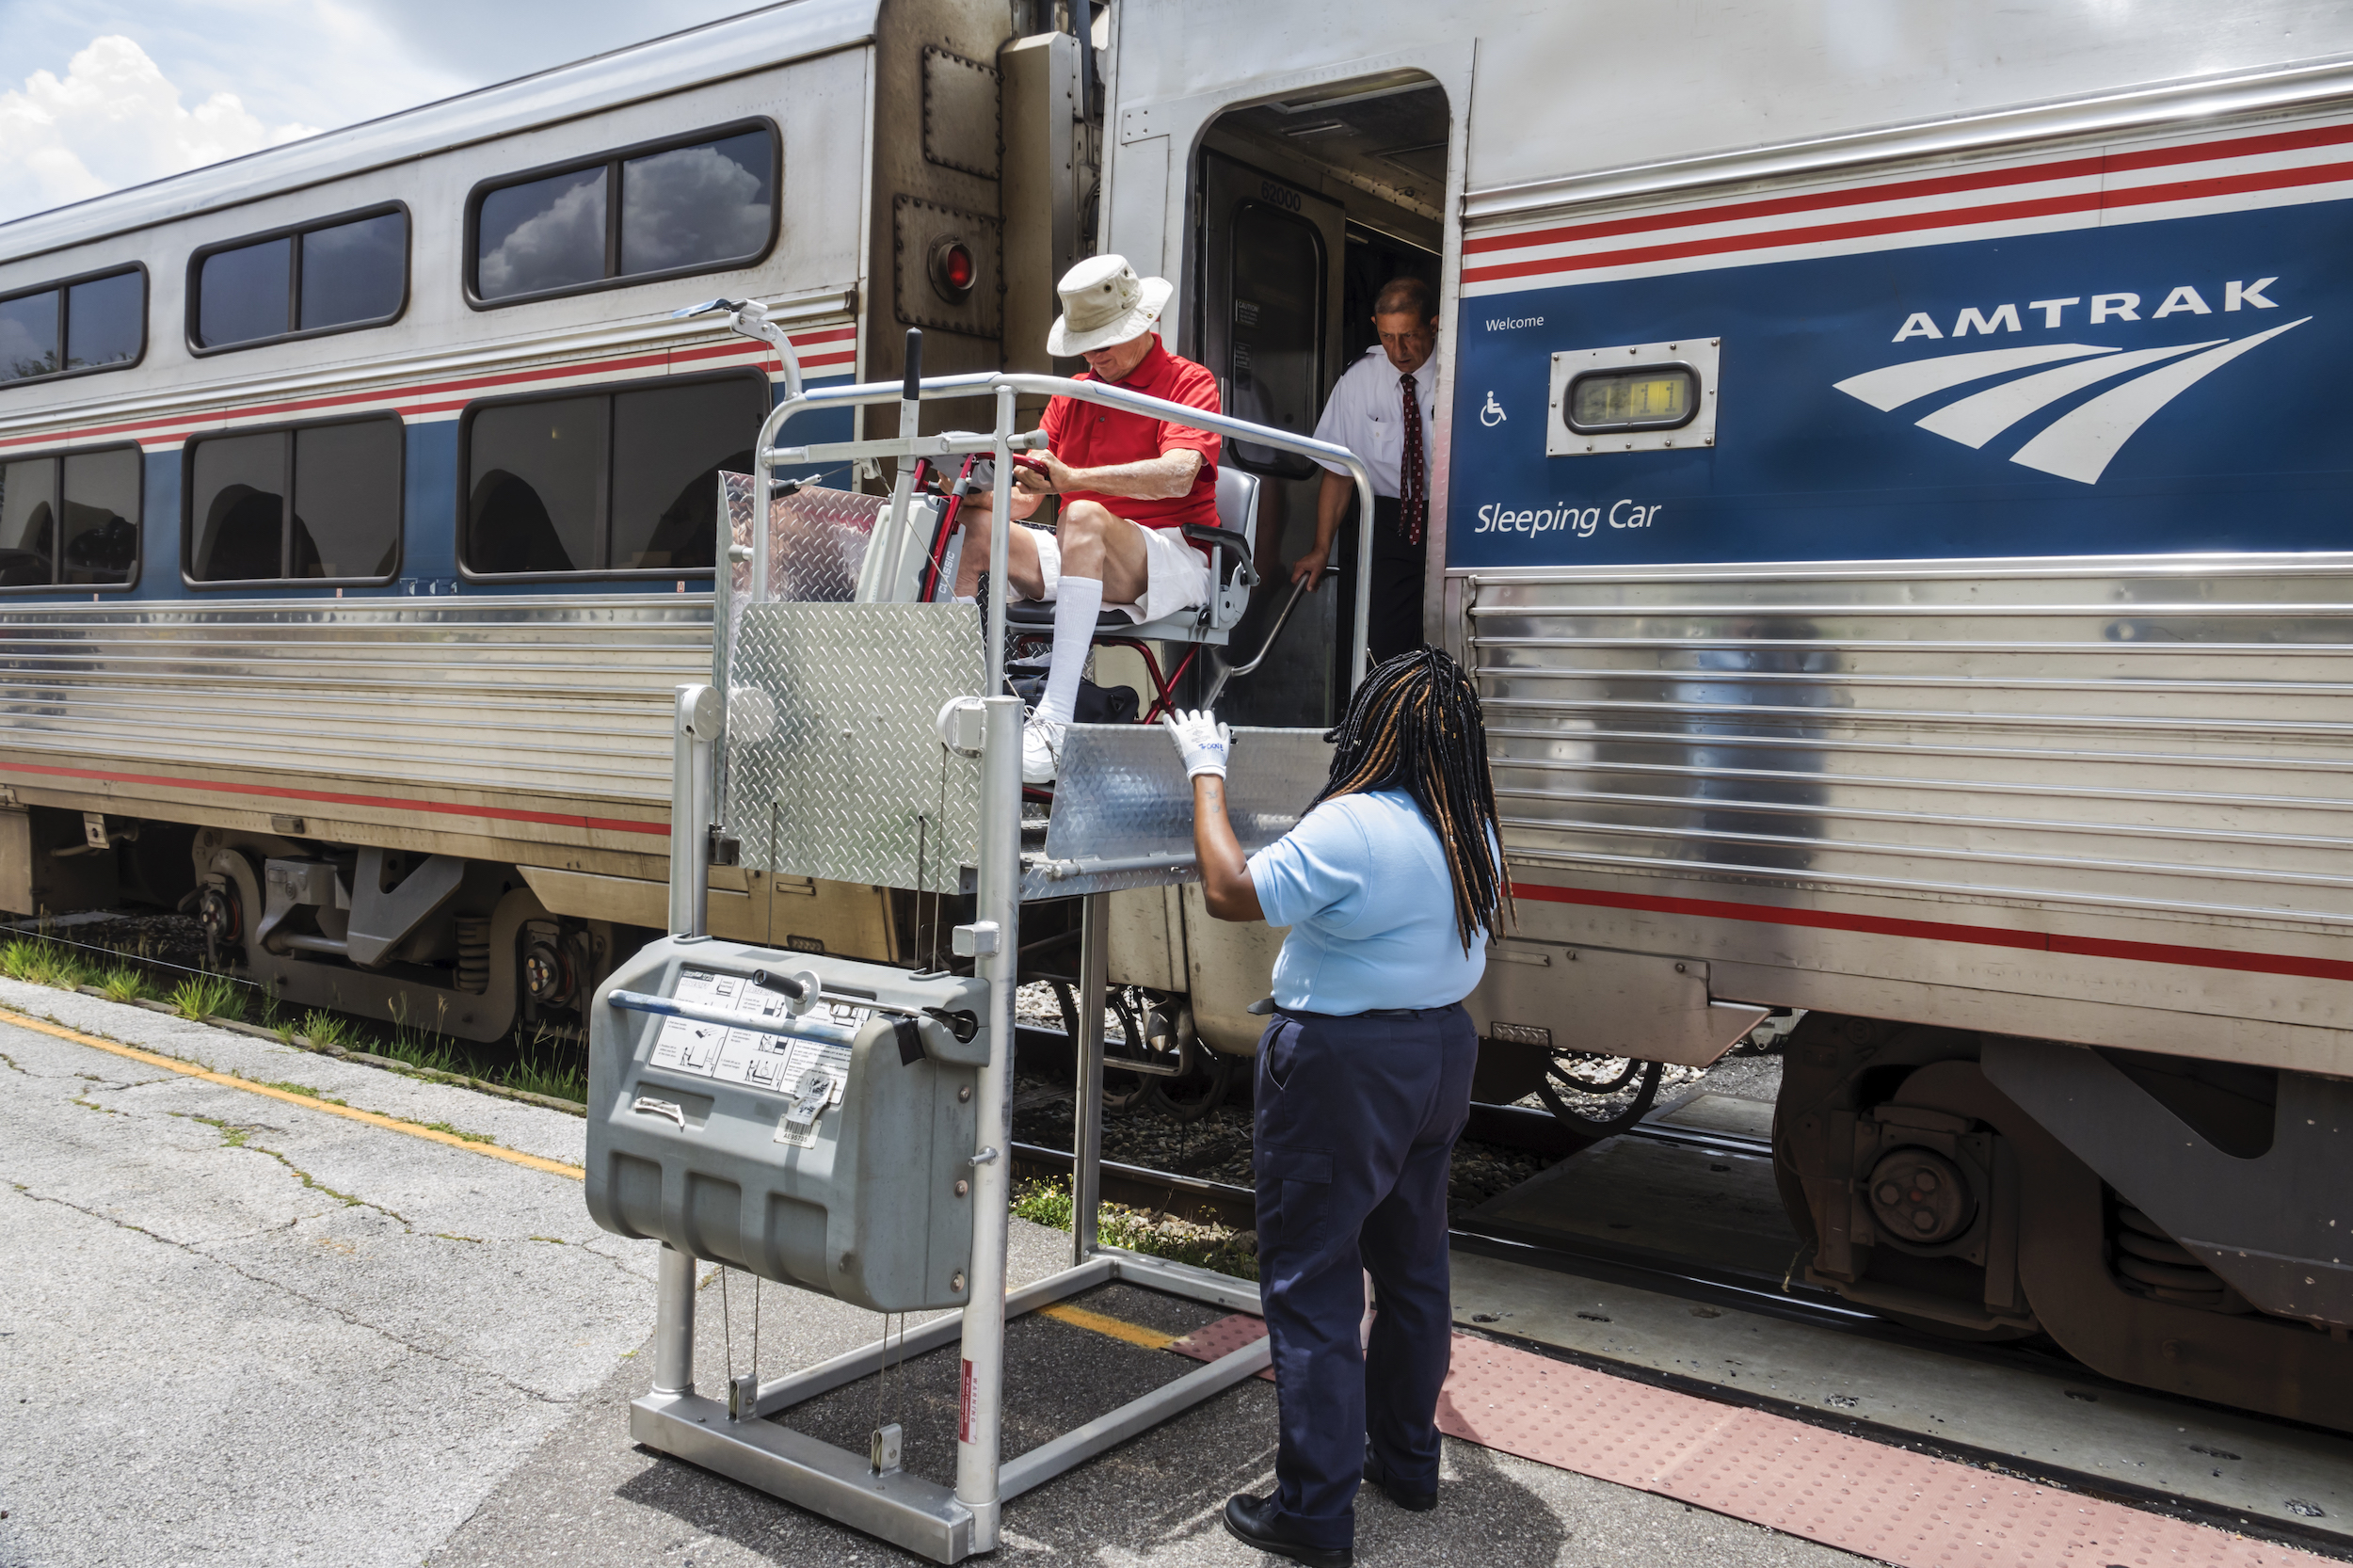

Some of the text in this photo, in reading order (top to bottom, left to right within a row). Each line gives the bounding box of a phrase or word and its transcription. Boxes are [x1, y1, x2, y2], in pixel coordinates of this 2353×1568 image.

[1261, 180, 1302, 212] 62000
[1238, 300, 1258, 312] CAUTION
[1891, 276, 2281, 343] AMTRAK
[1485, 316, 1545, 331] Welcome
[1474, 499, 1662, 539] Sleeping Car
[937, 551, 955, 594] CLASSIC
[783, 1132, 808, 1143] AE95735
